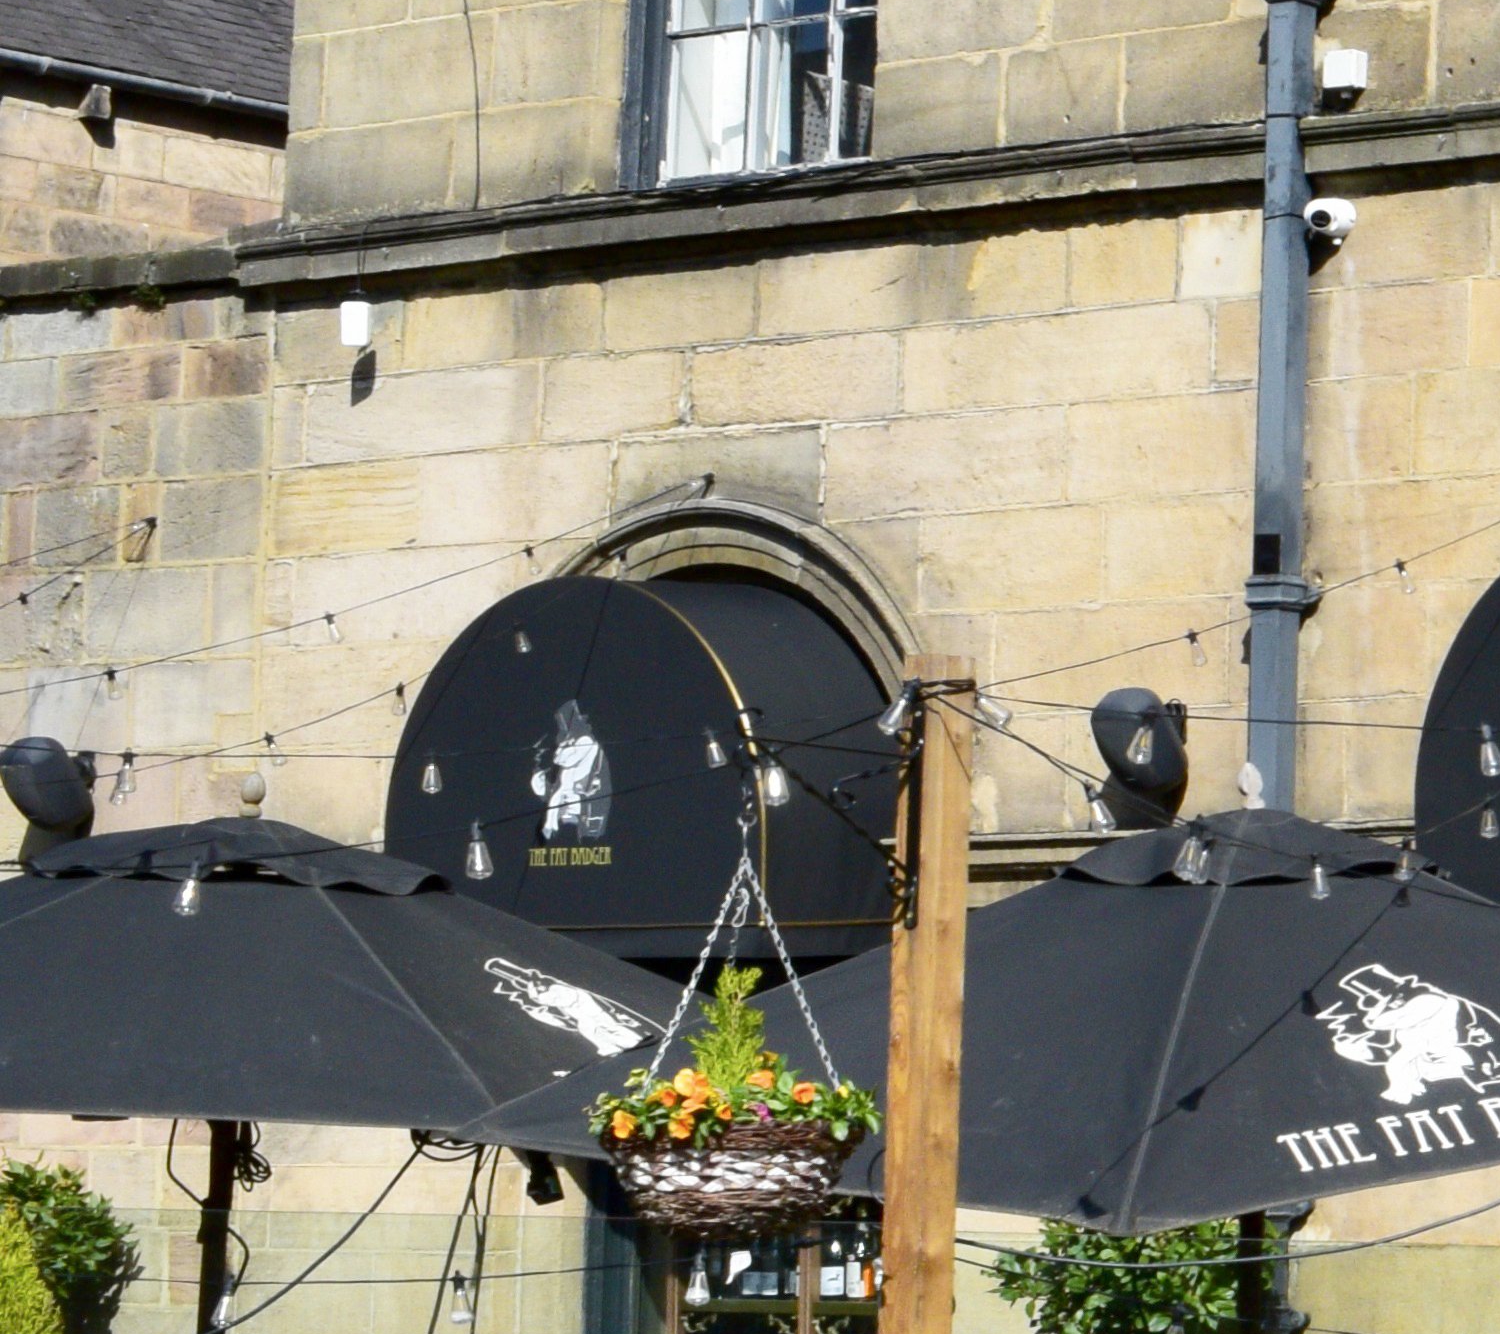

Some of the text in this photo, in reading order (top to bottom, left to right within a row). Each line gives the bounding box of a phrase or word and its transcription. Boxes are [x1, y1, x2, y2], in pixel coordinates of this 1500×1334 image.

[549, 848, 568, 866] FAT
[1276, 1123, 1378, 1172] THE
[1375, 1103, 1476, 1157] FAT
